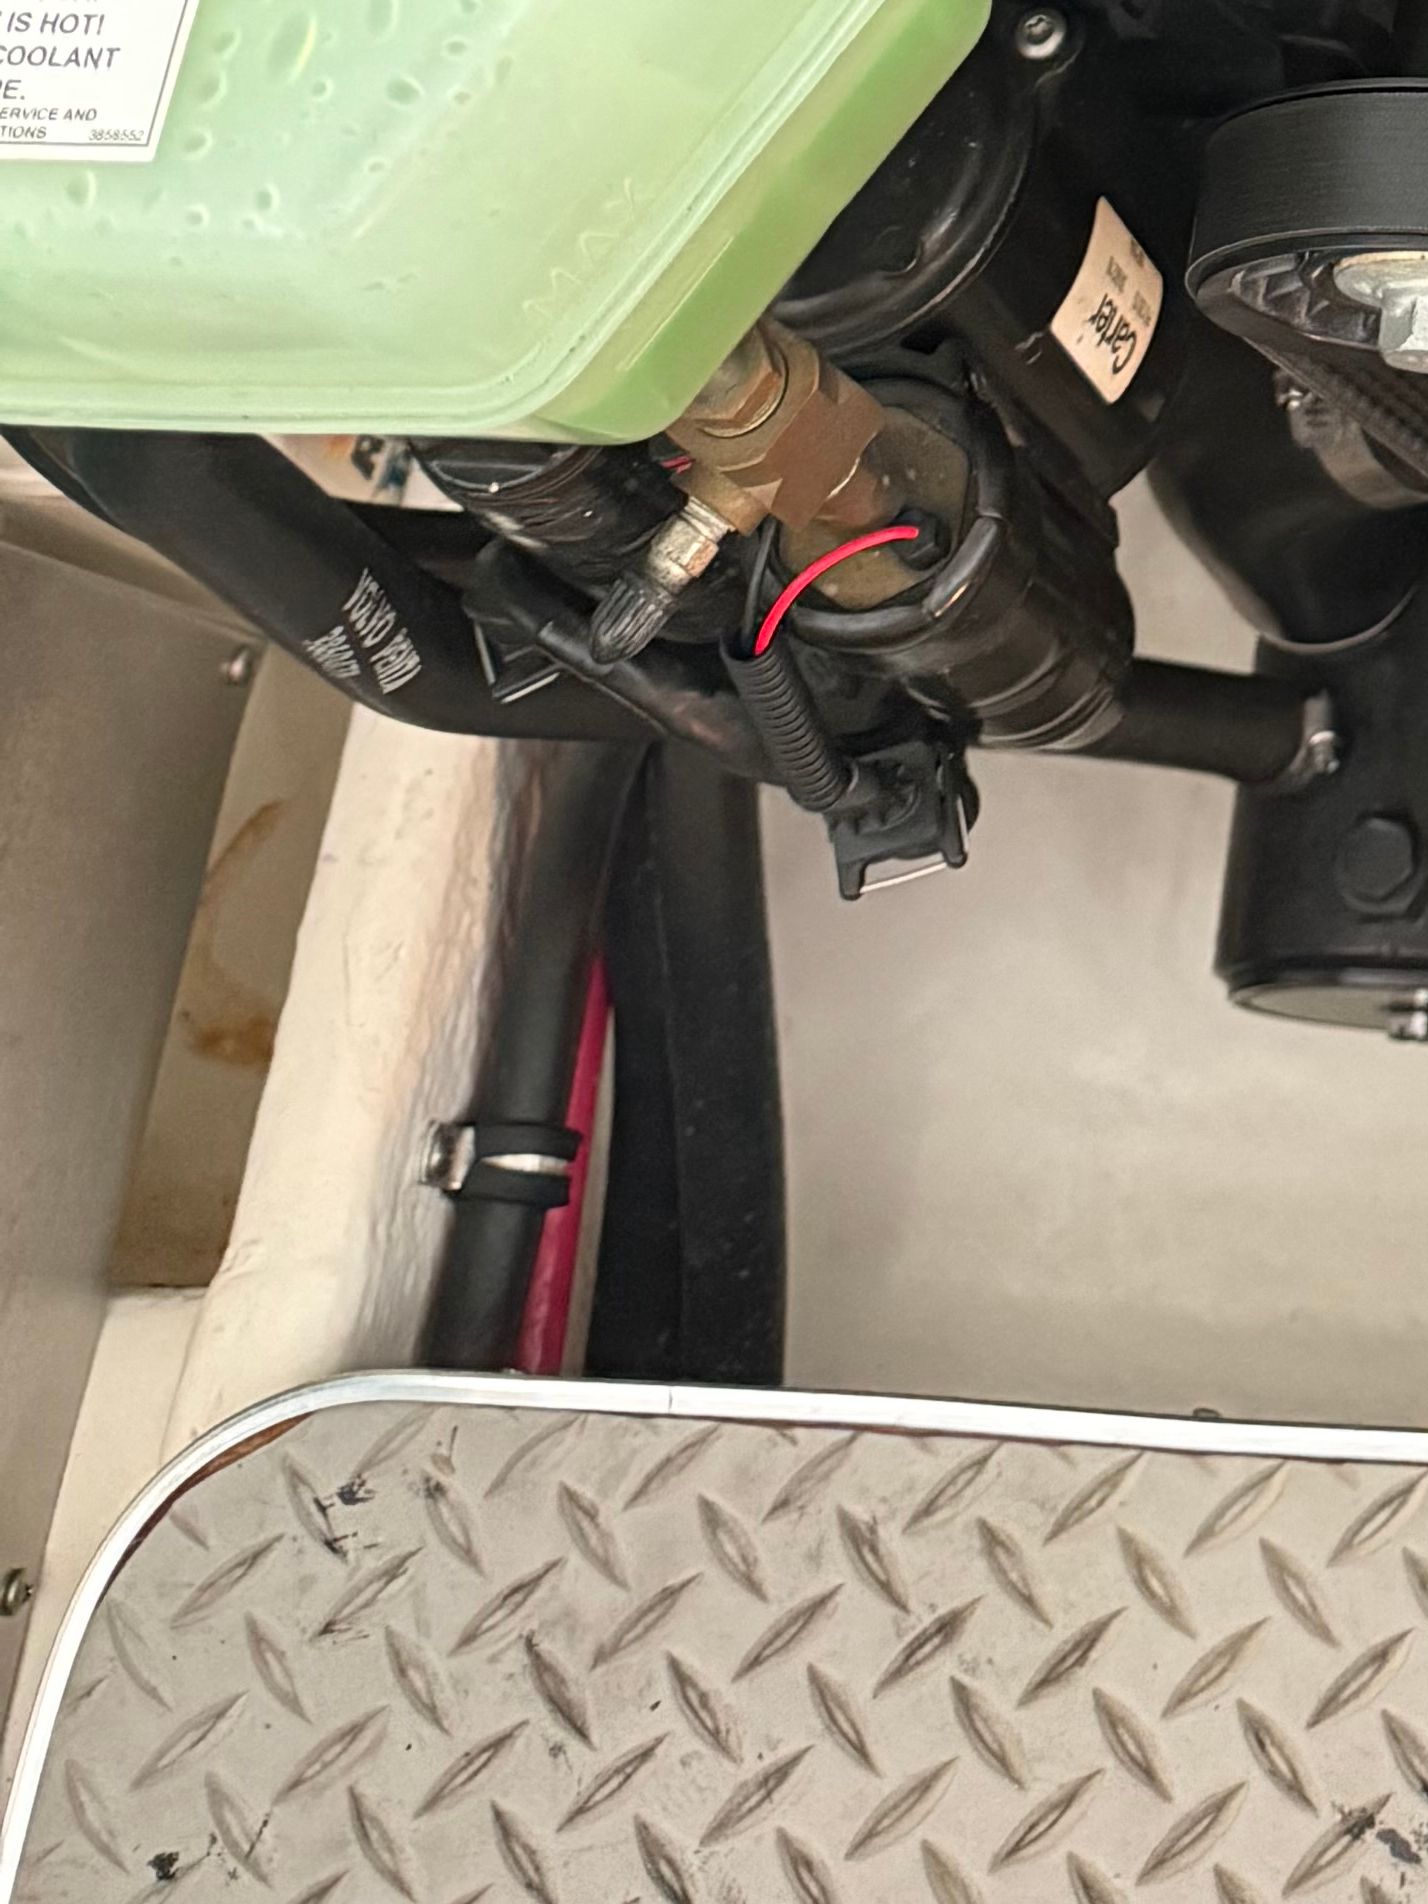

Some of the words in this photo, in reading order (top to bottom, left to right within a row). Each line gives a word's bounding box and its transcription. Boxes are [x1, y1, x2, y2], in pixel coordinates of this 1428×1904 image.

[7, 11, 33, 33] IS
[0, 44, 121, 70] COOLANT
[63, 107, 98, 122] AND
[1088, 293, 1138, 376] Carter
[341, 566, 397, 649] VOLVO
[369, 626, 423, 695] PENTA
